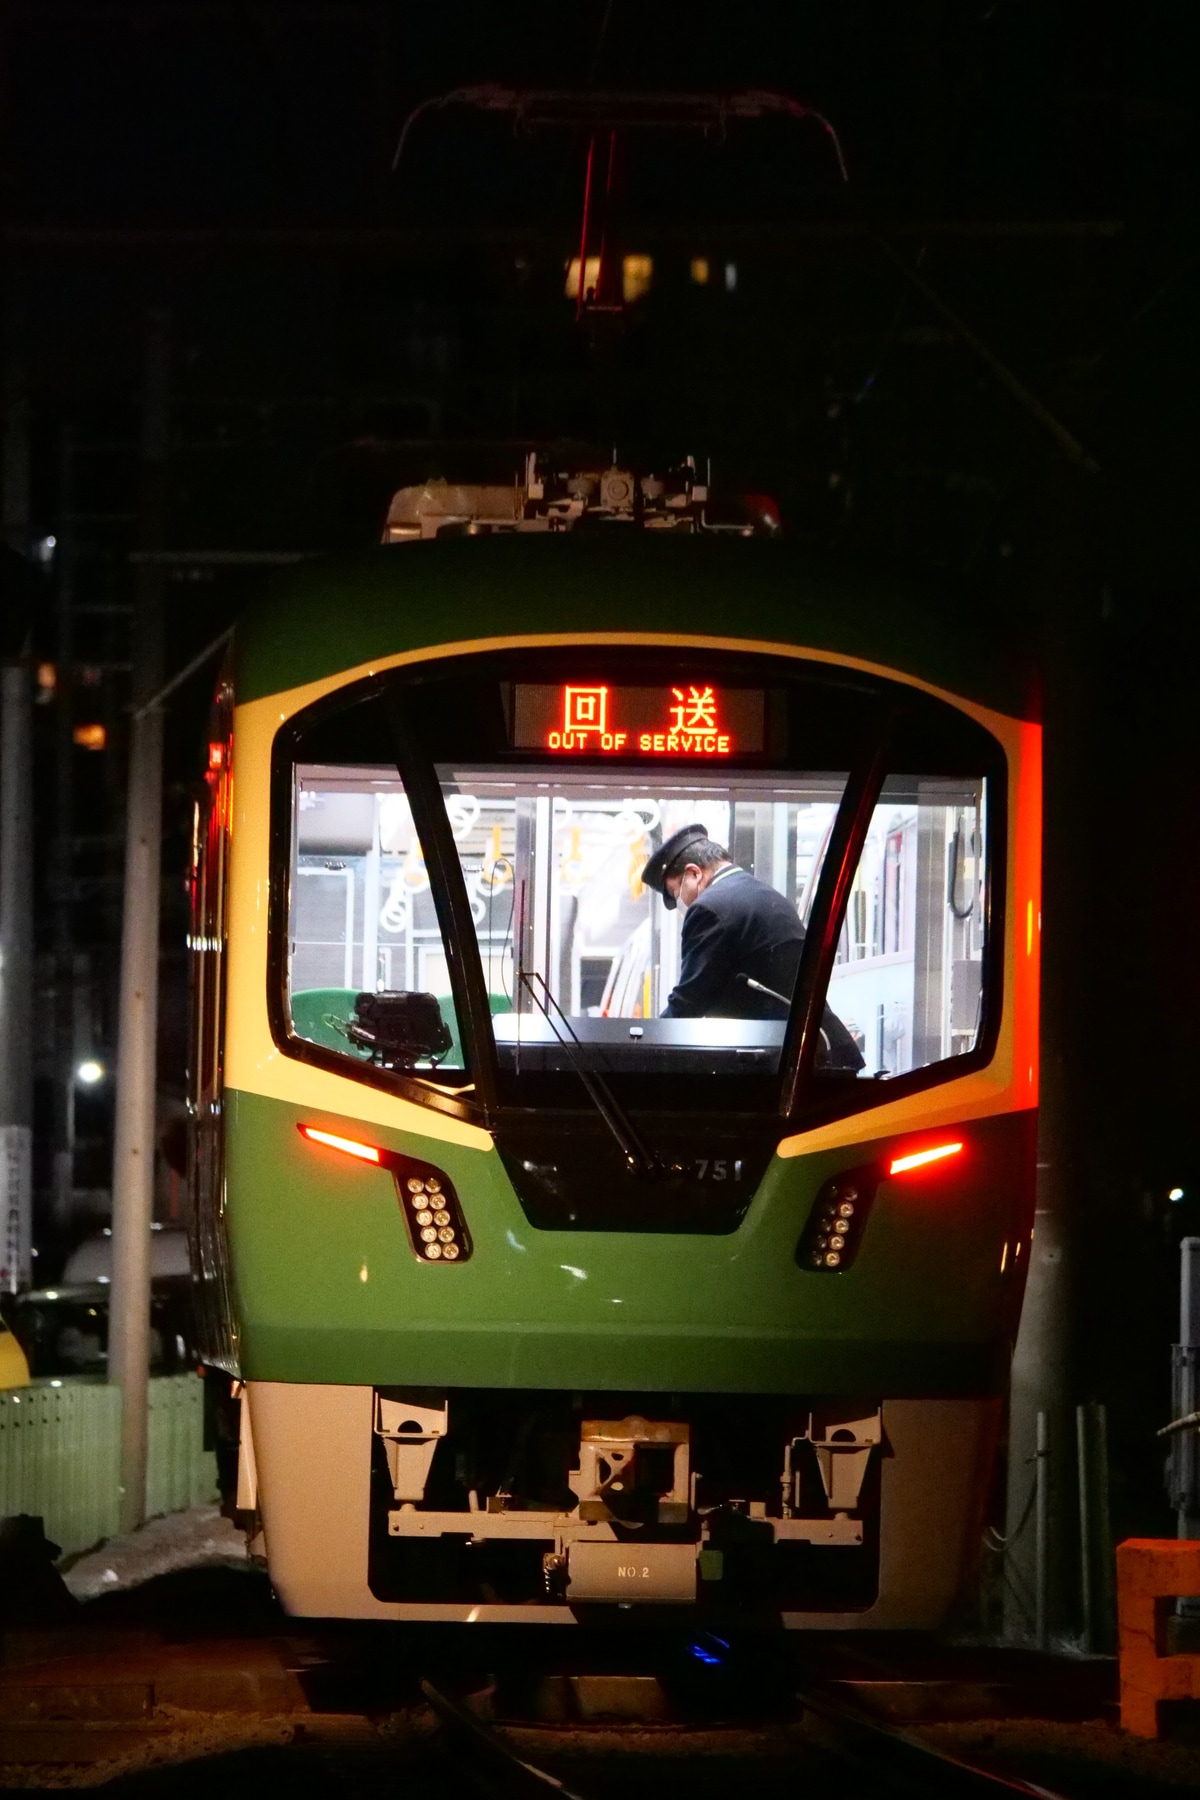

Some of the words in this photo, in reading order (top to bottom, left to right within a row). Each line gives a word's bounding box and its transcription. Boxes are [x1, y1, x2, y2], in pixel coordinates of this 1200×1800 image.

[548, 733, 588, 750] OUT
[601, 734, 627, 750] OF
[640, 735, 730, 753] SERVICE
[695, 1159, 742, 1181] 751
